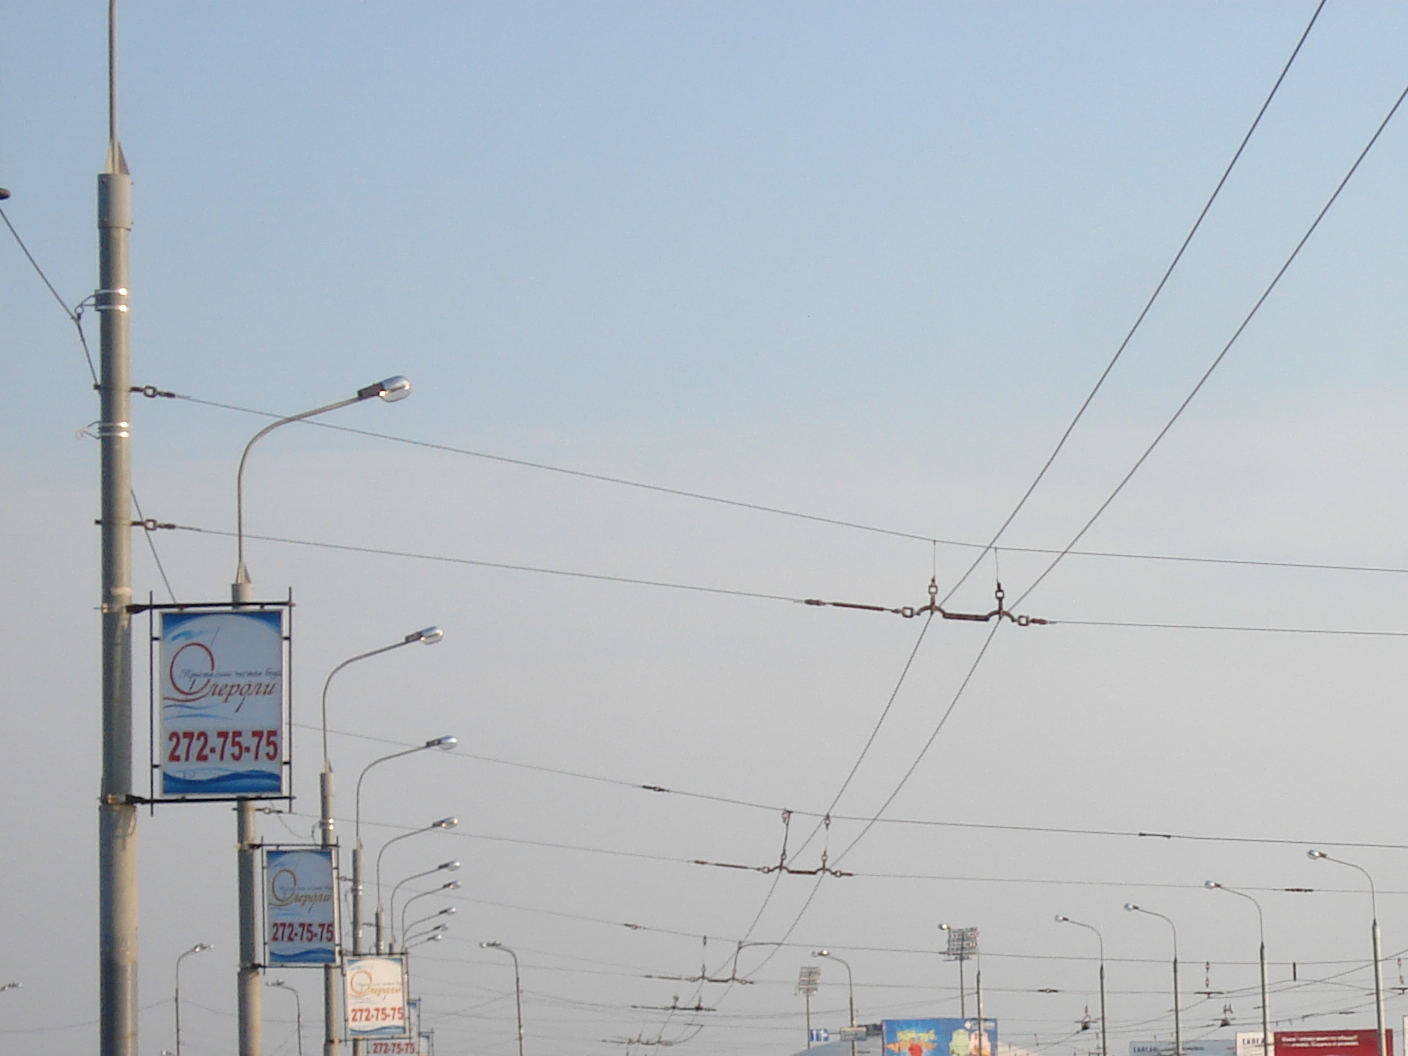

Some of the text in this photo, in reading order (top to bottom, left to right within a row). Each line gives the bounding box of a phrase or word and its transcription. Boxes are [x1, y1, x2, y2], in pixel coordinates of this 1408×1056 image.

[168, 730, 279, 763] 272-75-75
[272, 922, 335, 943] 272-75-75
[351, 1007, 405, 1022] 272-75-75
[373, 1042, 415, 1054] 272-75-75
